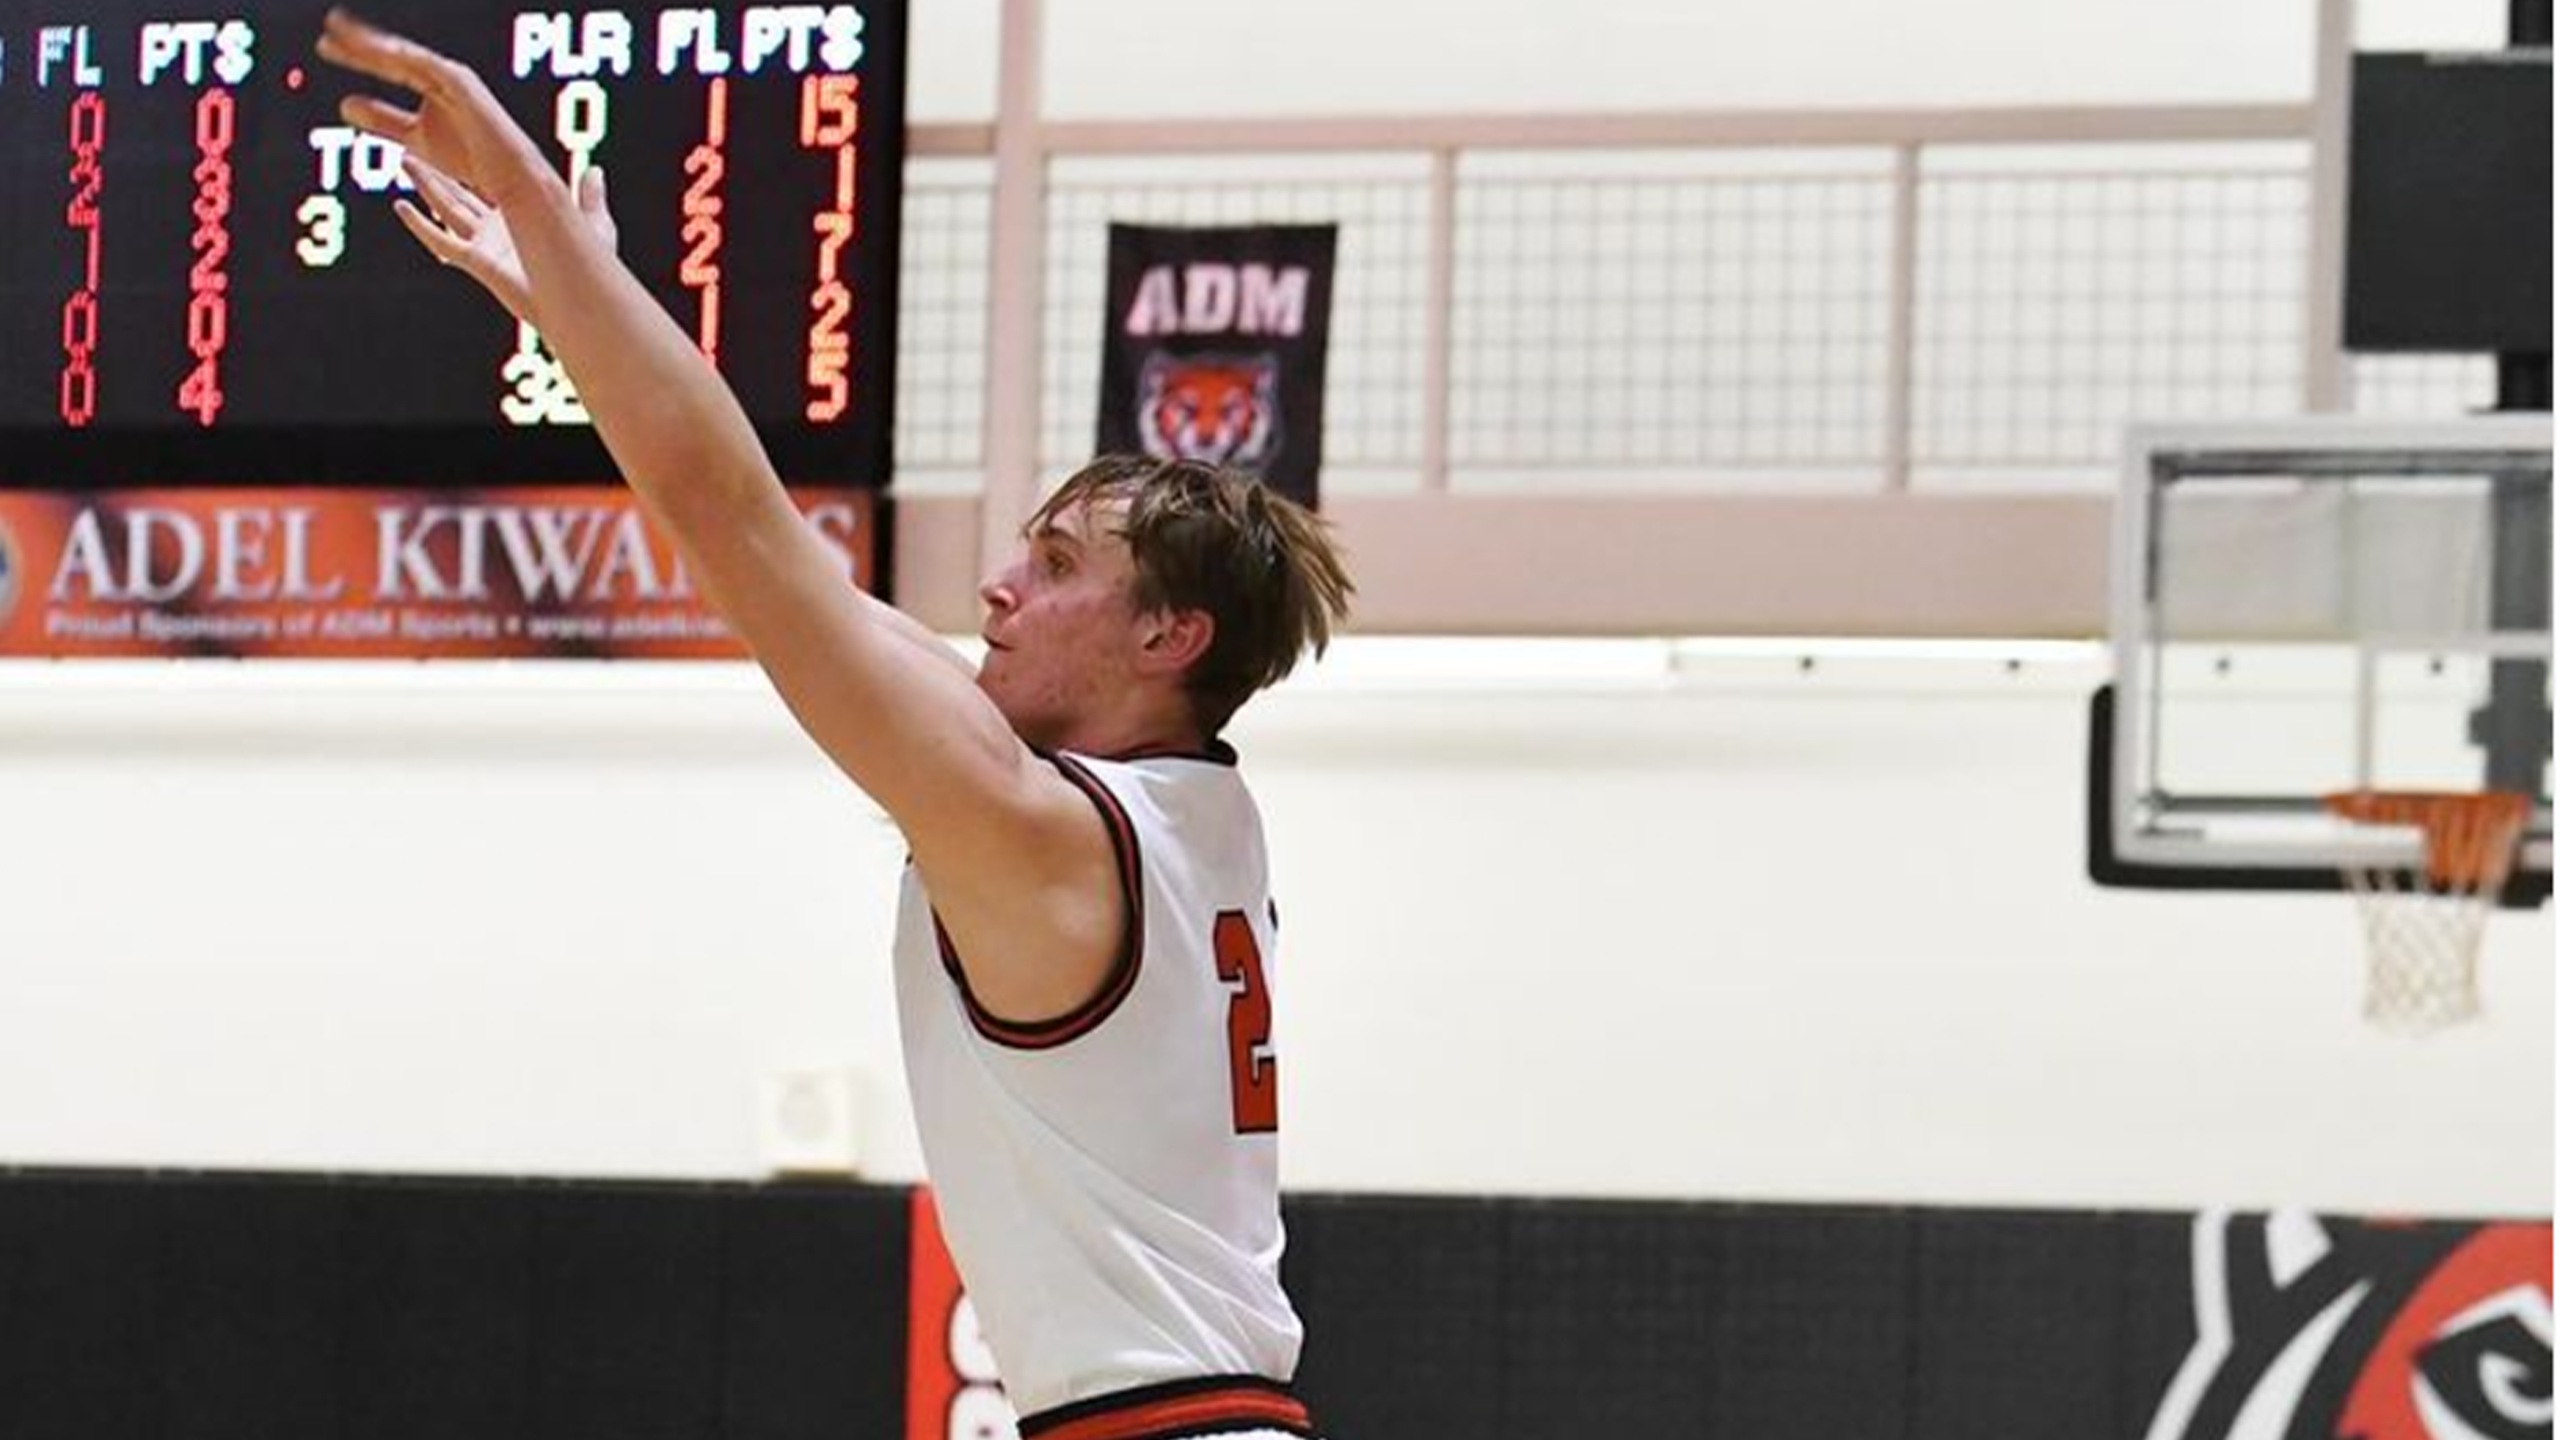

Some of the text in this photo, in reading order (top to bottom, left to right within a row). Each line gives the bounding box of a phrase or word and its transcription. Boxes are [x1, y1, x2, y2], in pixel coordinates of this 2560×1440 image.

[38, 25, 101, 87] FL
[139, 20, 254, 86] PTS
[513, 6, 864, 77] PLR FL PTS
[71, 89, 234, 153] 0 0
[556, 75, 858, 150] 0 1 15
[194, 156, 231, 221] 3
[684, 146, 724, 215] 2
[837, 144, 856, 213] 1
[191, 222, 229, 291] 2
[296, 195, 345, 266] 3
[681, 212, 853, 284] 2 7
[63, 290, 227, 358] 0 0
[812, 281, 851, 351] 2
[1126, 262, 1309, 337] ADM
[62, 357, 224, 426] 0 4
[807, 350, 848, 421] 5
[52, 506, 345, 600] ADEL
